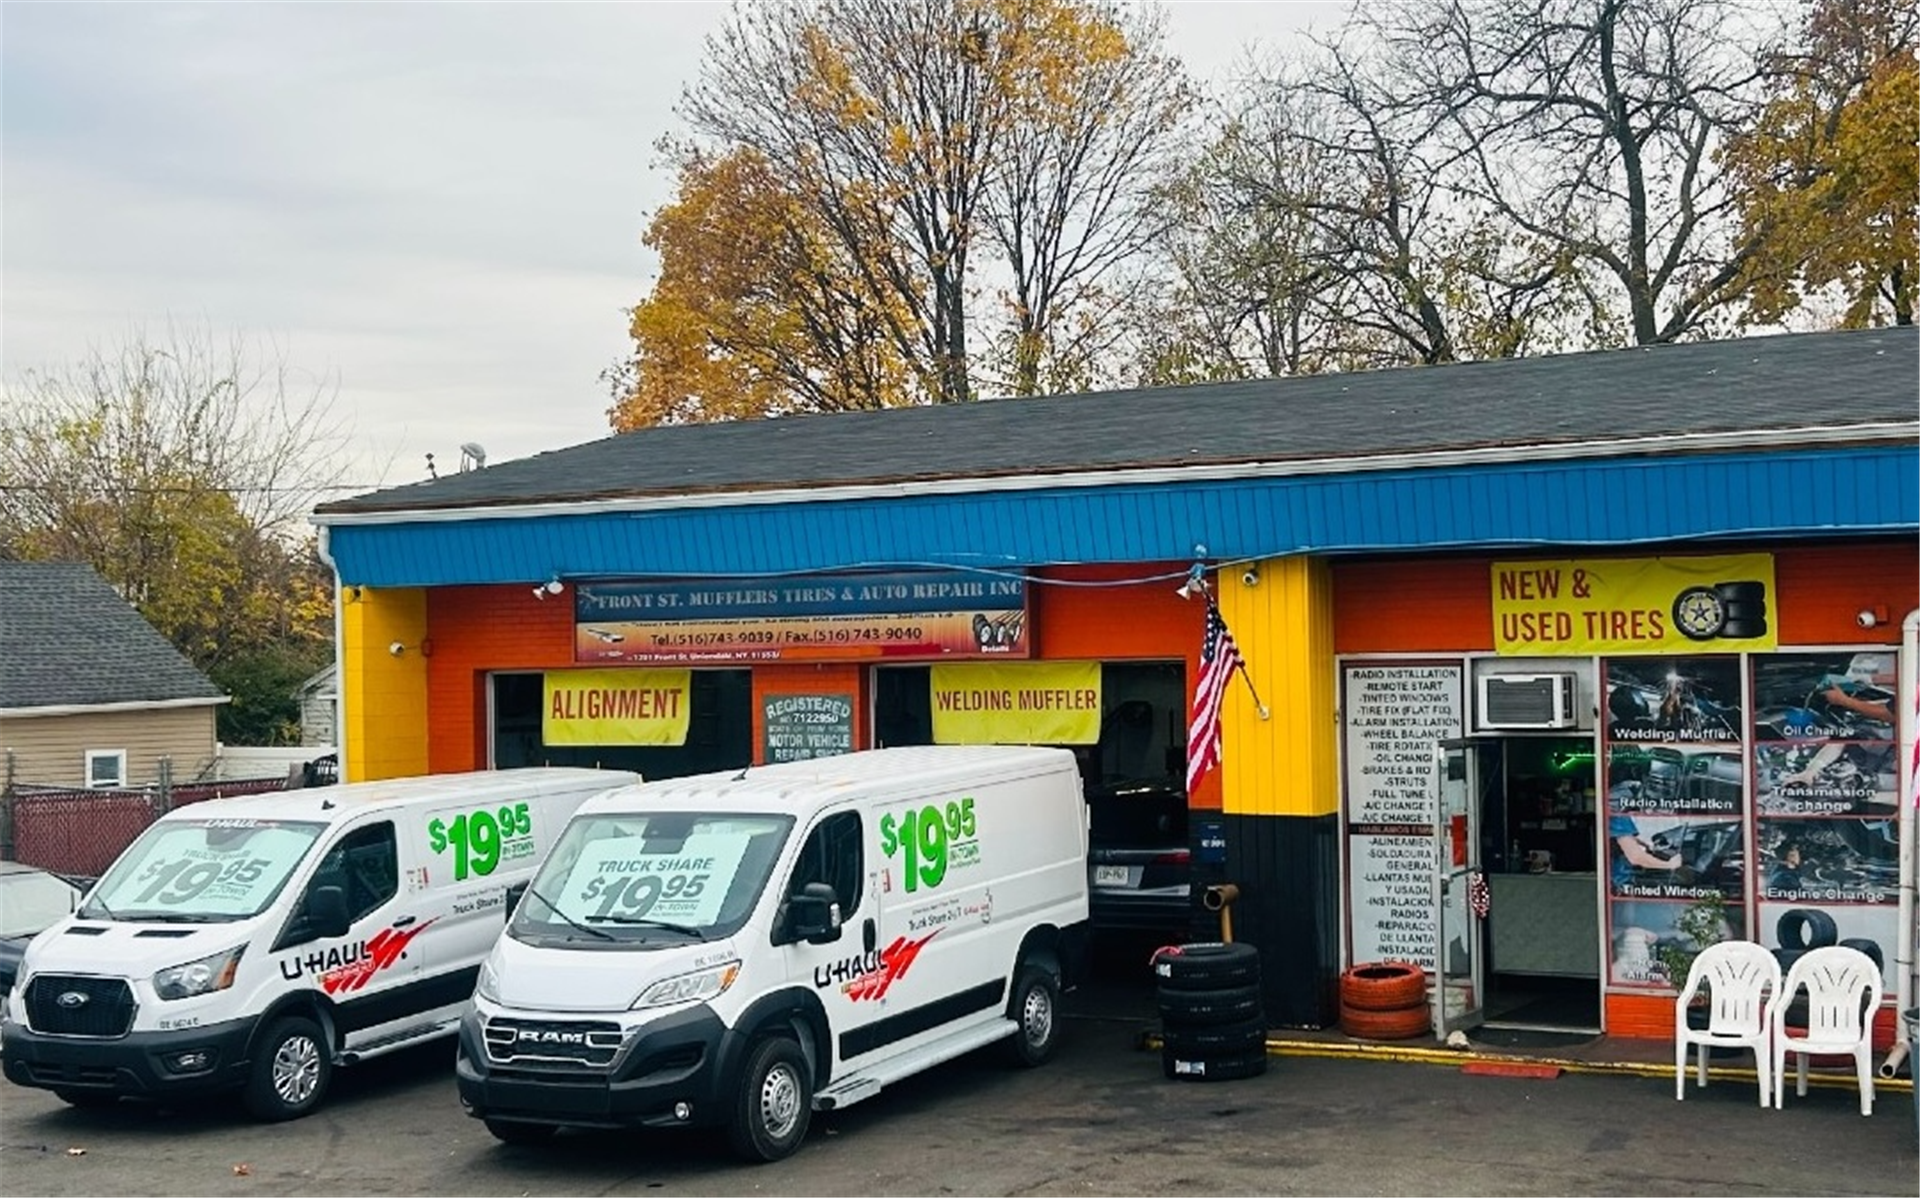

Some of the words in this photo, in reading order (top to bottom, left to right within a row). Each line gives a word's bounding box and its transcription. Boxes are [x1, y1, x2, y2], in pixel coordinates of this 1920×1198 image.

[1500, 569, 1560, 600] NEW
[1572, 569, 1591, 598] &
[599, 594, 653, 609] FRONT
[657, 593, 684, 607] ST.
[689, 590, 778, 606] MUFFLERS
[783, 587, 836, 603] TIRES
[841, 587, 853, 600] &
[859, 584, 908, 600] AUTO
[913, 581, 984, 598] REPAIR
[989, 580, 1022, 595] INC
[1502, 612, 1572, 642] USED
[1582, 610, 1664, 640] TIRES
[853, 627, 922, 641] 743-9040
[1387, 669, 1458, 679] INSTALLATION
[1411, 681, 1443, 691] START
[552, 688, 682, 719] ALIGNMENT
[936, 690, 1012, 711] WELDING
[1018, 689, 1097, 710] MUFFLER
[1400, 693, 1449, 702] WINDOWS
[766, 697, 851, 719] REGISTERED
[1389, 718, 1460, 727] INSTALLATION
[1401, 729, 1449, 738] BALANCE
[1615, 727, 1675, 741] Welding
[1679, 727, 1733, 740] Muffler
[1783, 725, 1802, 736] Oil
[1805, 725, 1855, 738] Change
[768, 734, 804, 748] MOTOR
[807, 734, 849, 748] VEHICLE
[1400, 789, 1426, 798] TUNE
[1771, 785, 1876, 798] Transmission
[1383, 801, 1426, 810] CHANGE
[1619, 798, 1657, 809] Radio
[1660, 798, 1733, 810] Installation
[1796, 799, 1852, 812] change
[1381, 813, 1424, 822] CHANGE
[598, 860, 652, 873] TRUCK
[657, 857, 715, 871] SHARE
[1386, 861, 1434, 871] GENERAL
[1623, 886, 1661, 897] Tinted
[1767, 888, 1819, 901] Engine
[1826, 888, 1885, 902] Change
[1390, 909, 1429, 919] RADIOS
[280, 940, 372, 980] U-HAUL
[814, 949, 888, 989] U-HAUL
[518, 1030, 581, 1043] RAM
